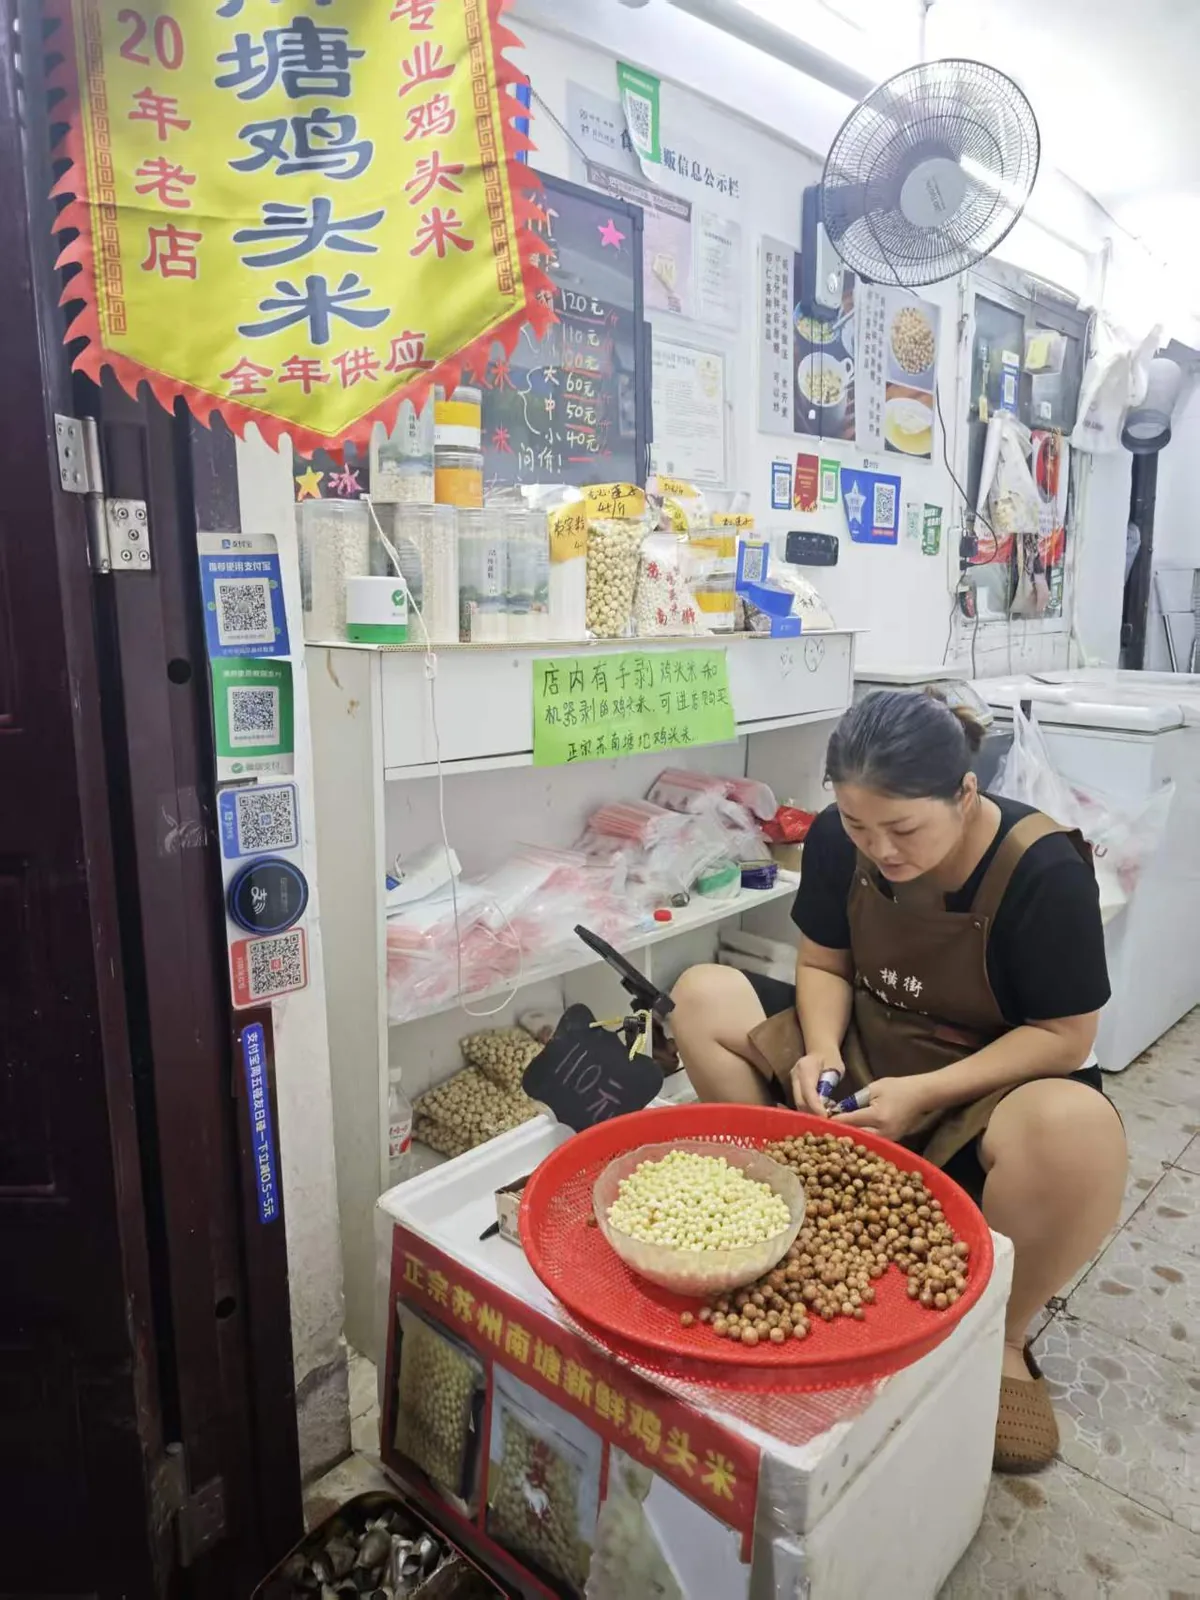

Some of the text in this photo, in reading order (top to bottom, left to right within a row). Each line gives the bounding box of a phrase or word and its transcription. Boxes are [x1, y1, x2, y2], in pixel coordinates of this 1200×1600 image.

[116, 8, 202, 281] 20年老店
[214, 0, 391, 345] 塘鸡头米
[219, 329, 436, 396] 全年供应
[402, 1253, 737, 1501] 正宗苏州南塘新鲜鸡头米
